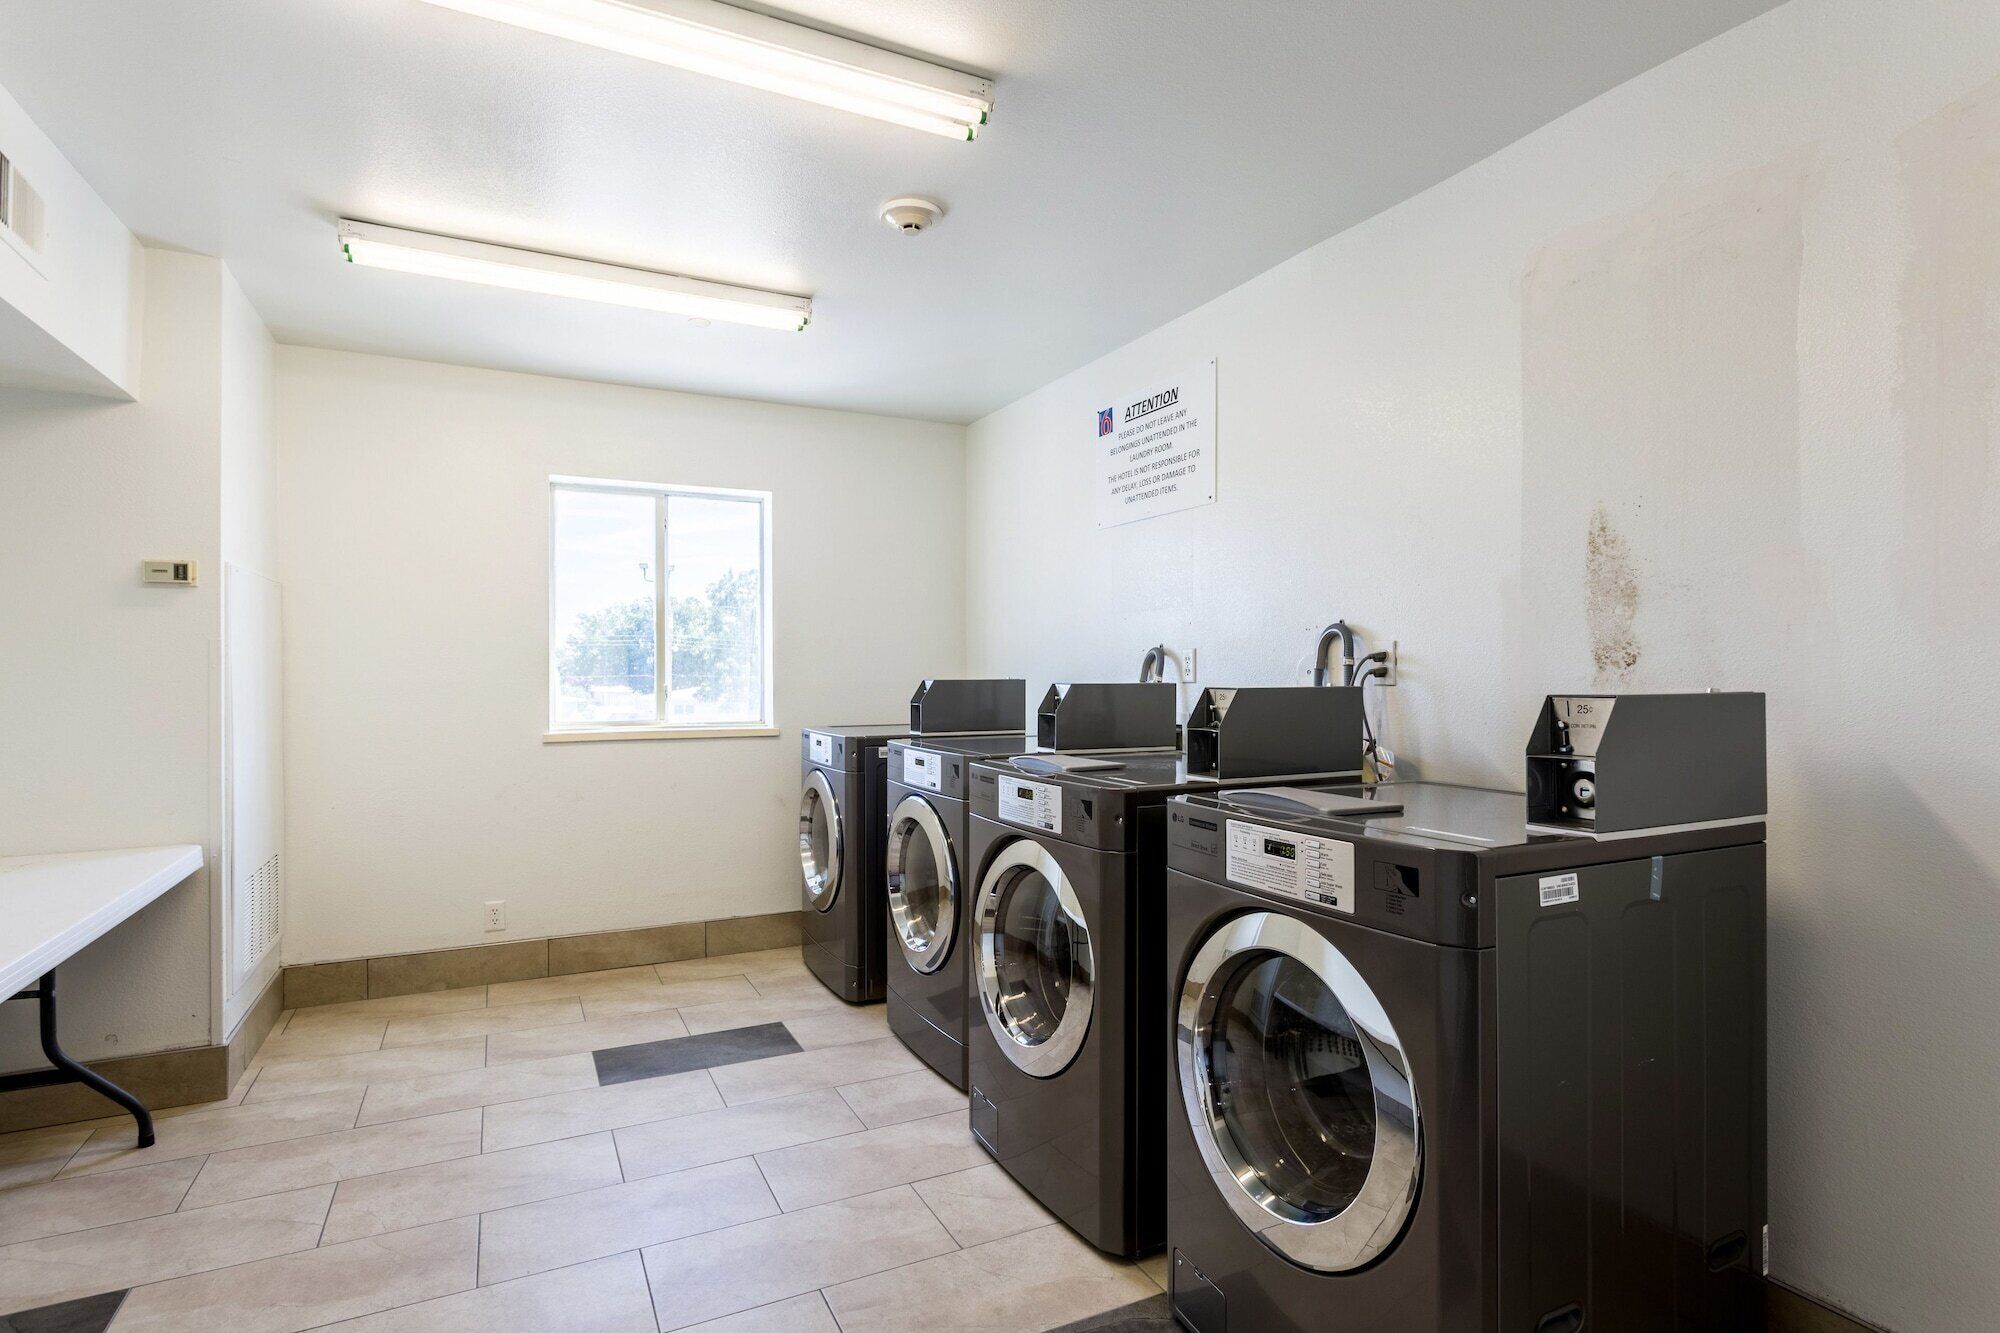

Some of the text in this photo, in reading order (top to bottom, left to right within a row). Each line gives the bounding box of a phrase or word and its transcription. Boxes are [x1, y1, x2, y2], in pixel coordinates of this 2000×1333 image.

[1125, 387, 1178, 422] ATTENTION
[1110, 418, 1197, 456] BELONGINGS UNATTENDED IN THE
[1118, 408, 1187, 440] PLEASE DO NOT LEAVE ANY
[1108, 449, 1201, 484] THE HOTEL IS NOT RESPONSIBLE FOR
[1130, 449, 1153, 463] LAUNDRY
[1111, 486, 1121, 495] ANY
[1139, 477, 1151, 488] LOSS
[1152, 473, 1160, 483] OR
[1162, 467, 1186, 481] DAMAGE
[1188, 465, 1196, 473] TO
[1124, 489, 1159, 504] UNATTENDED
